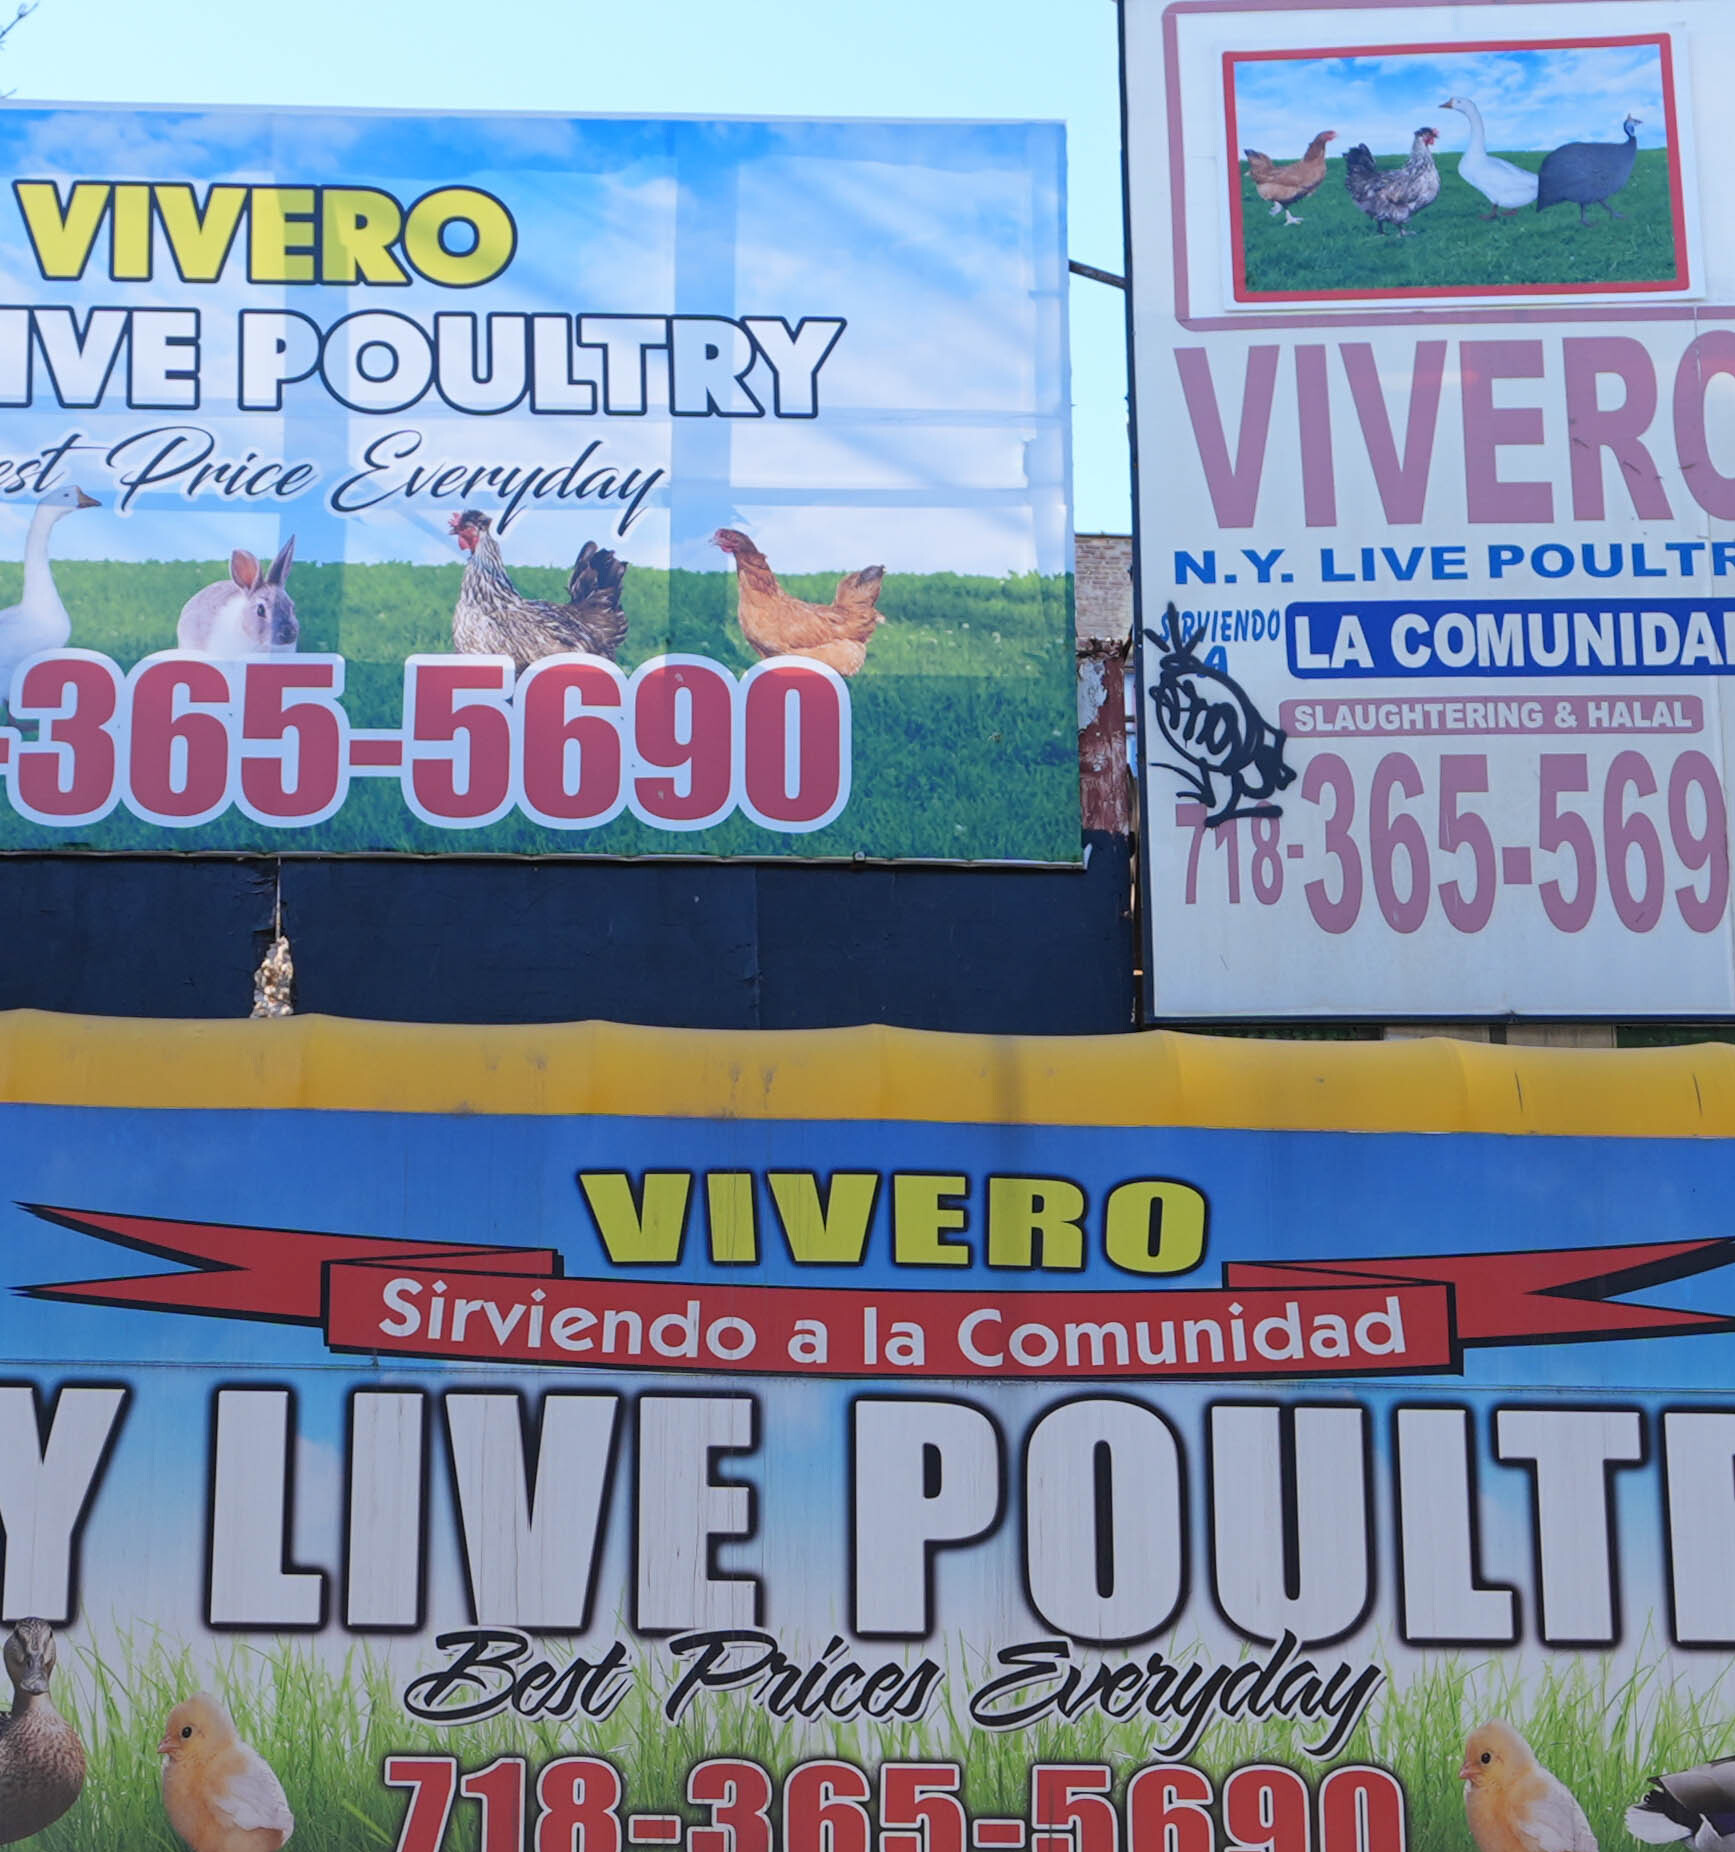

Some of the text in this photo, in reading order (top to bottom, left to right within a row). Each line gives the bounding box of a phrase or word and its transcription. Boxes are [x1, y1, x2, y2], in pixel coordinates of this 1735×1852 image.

[11, 178, 519, 288] VIVERO
[241, 308, 847, 420] POULTRY
[109, 430, 316, 514] Price
[331, 431, 666, 540] Everyday
[1174, 548, 1295, 586] N.Y.
[1320, 546, 1467, 583] LIVE
[1294, 613, 1375, 670] LA
[1293, 700, 1693, 732] SLAUGHTERING & HALAL
[578, 1170, 1209, 1275] VIVERO
[379, 1277, 1408, 1370] Sirviendo a la Comunidad
[207, 1386, 769, 1634] LIVE
[403, 1624, 1387, 1762] Best Prices Everyday
